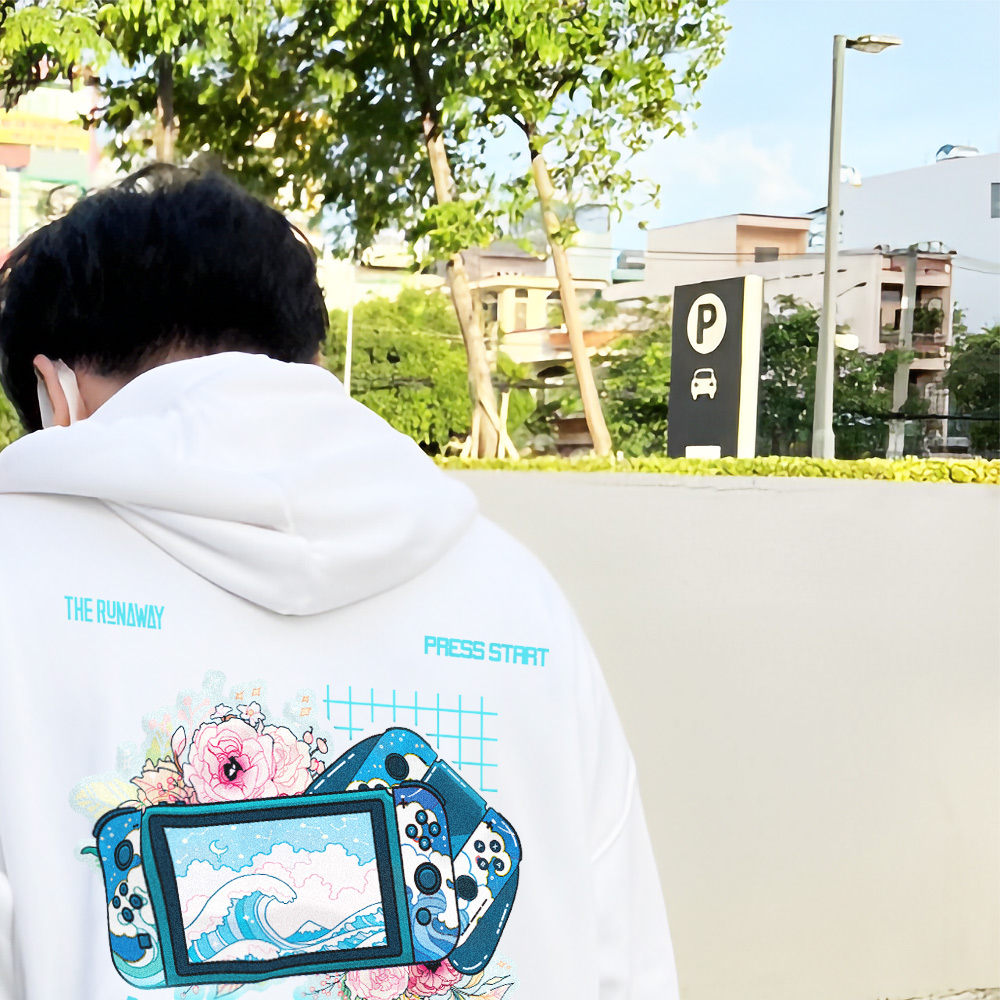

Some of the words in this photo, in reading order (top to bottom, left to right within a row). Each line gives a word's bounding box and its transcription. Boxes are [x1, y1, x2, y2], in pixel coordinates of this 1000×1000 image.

[696, 303, 717, 345] P
[63, 595, 94, 623] THE
[96, 598, 166, 631] RUNAWAY
[424, 635, 486, 661] PRESS
[488, 642, 550, 667] START
